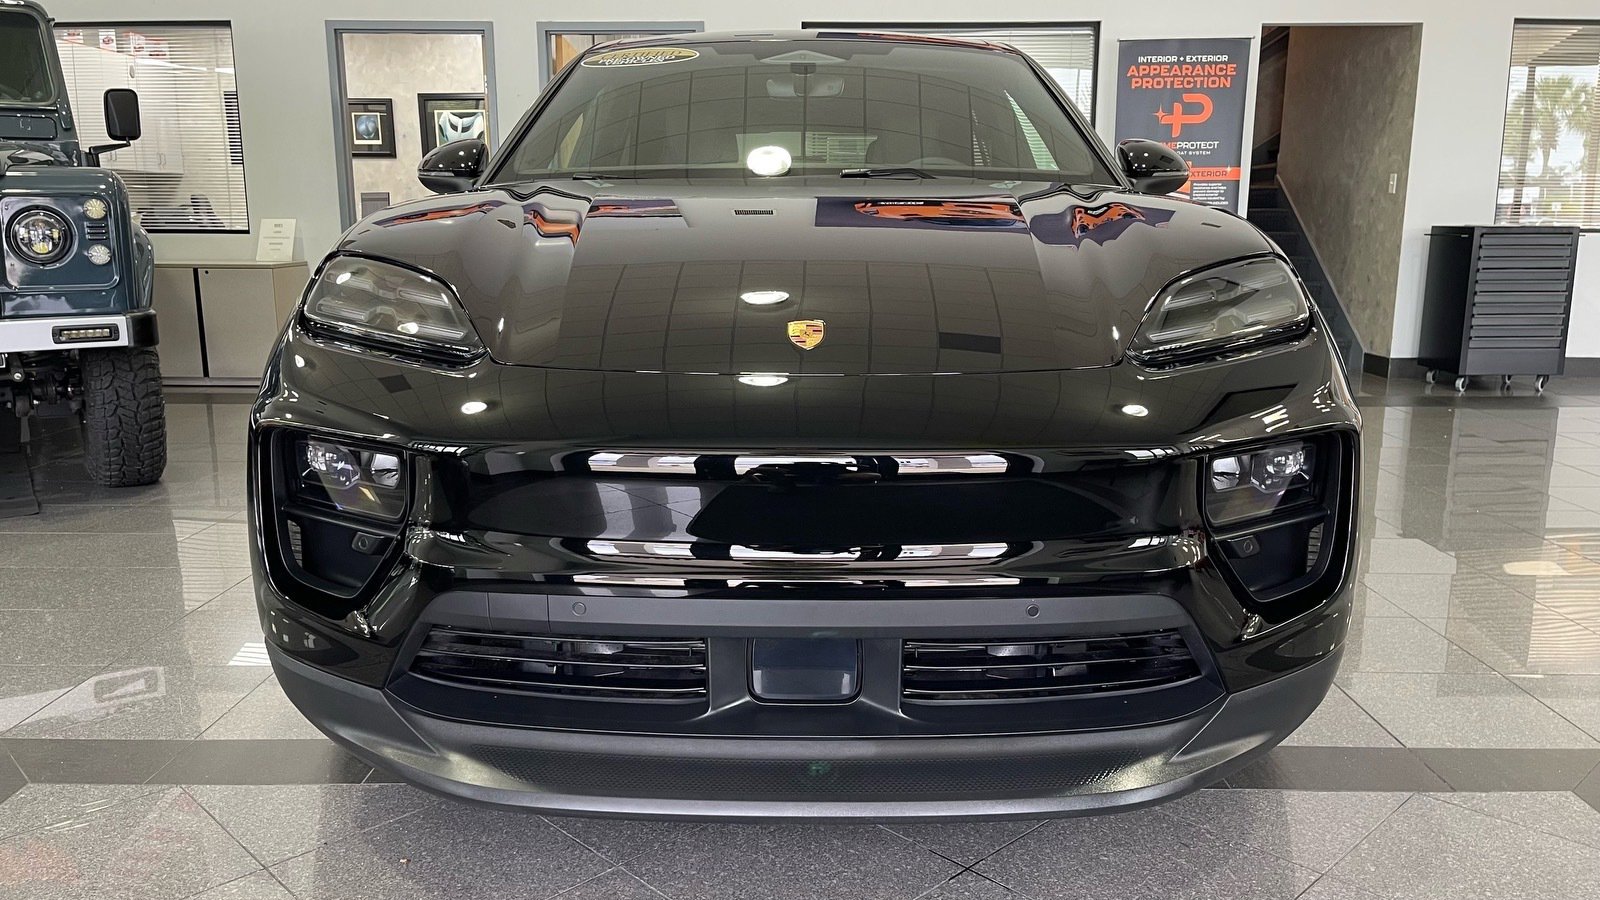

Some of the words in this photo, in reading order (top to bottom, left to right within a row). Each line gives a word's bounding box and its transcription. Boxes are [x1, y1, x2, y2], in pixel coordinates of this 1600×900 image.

[1138, 55, 1178, 63] INTERIOR
[1186, 54, 1229, 63] EXTERIOR
[1126, 63, 1237, 77] APPEARANCE
[1131, 76, 1231, 89] PROTECTION
[1161, 141, 1220, 150] MEPROTECT
